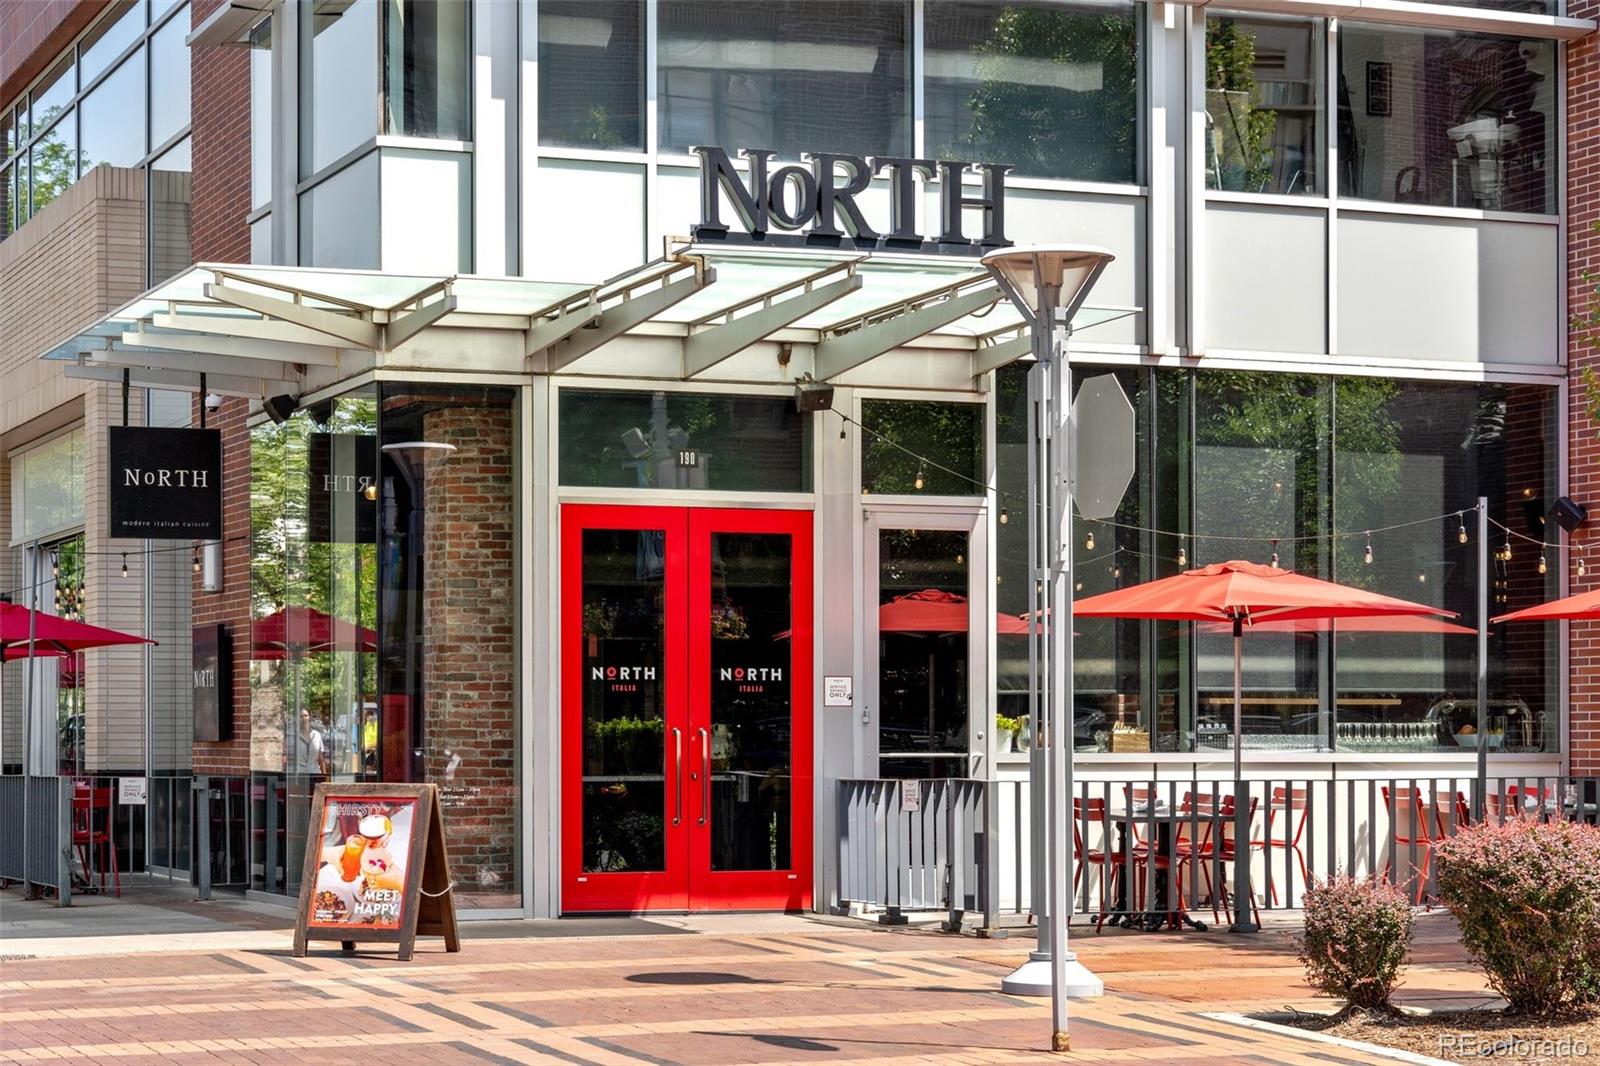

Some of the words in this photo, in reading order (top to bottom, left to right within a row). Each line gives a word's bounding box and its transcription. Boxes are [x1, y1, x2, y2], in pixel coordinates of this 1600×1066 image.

[679, 451, 696, 465] 190
[153, 520, 180, 528] italian
[611, 684, 637, 692] ITALIA
[738, 685, 764, 693] ITALIA
[364, 889, 399, 901] MEET
